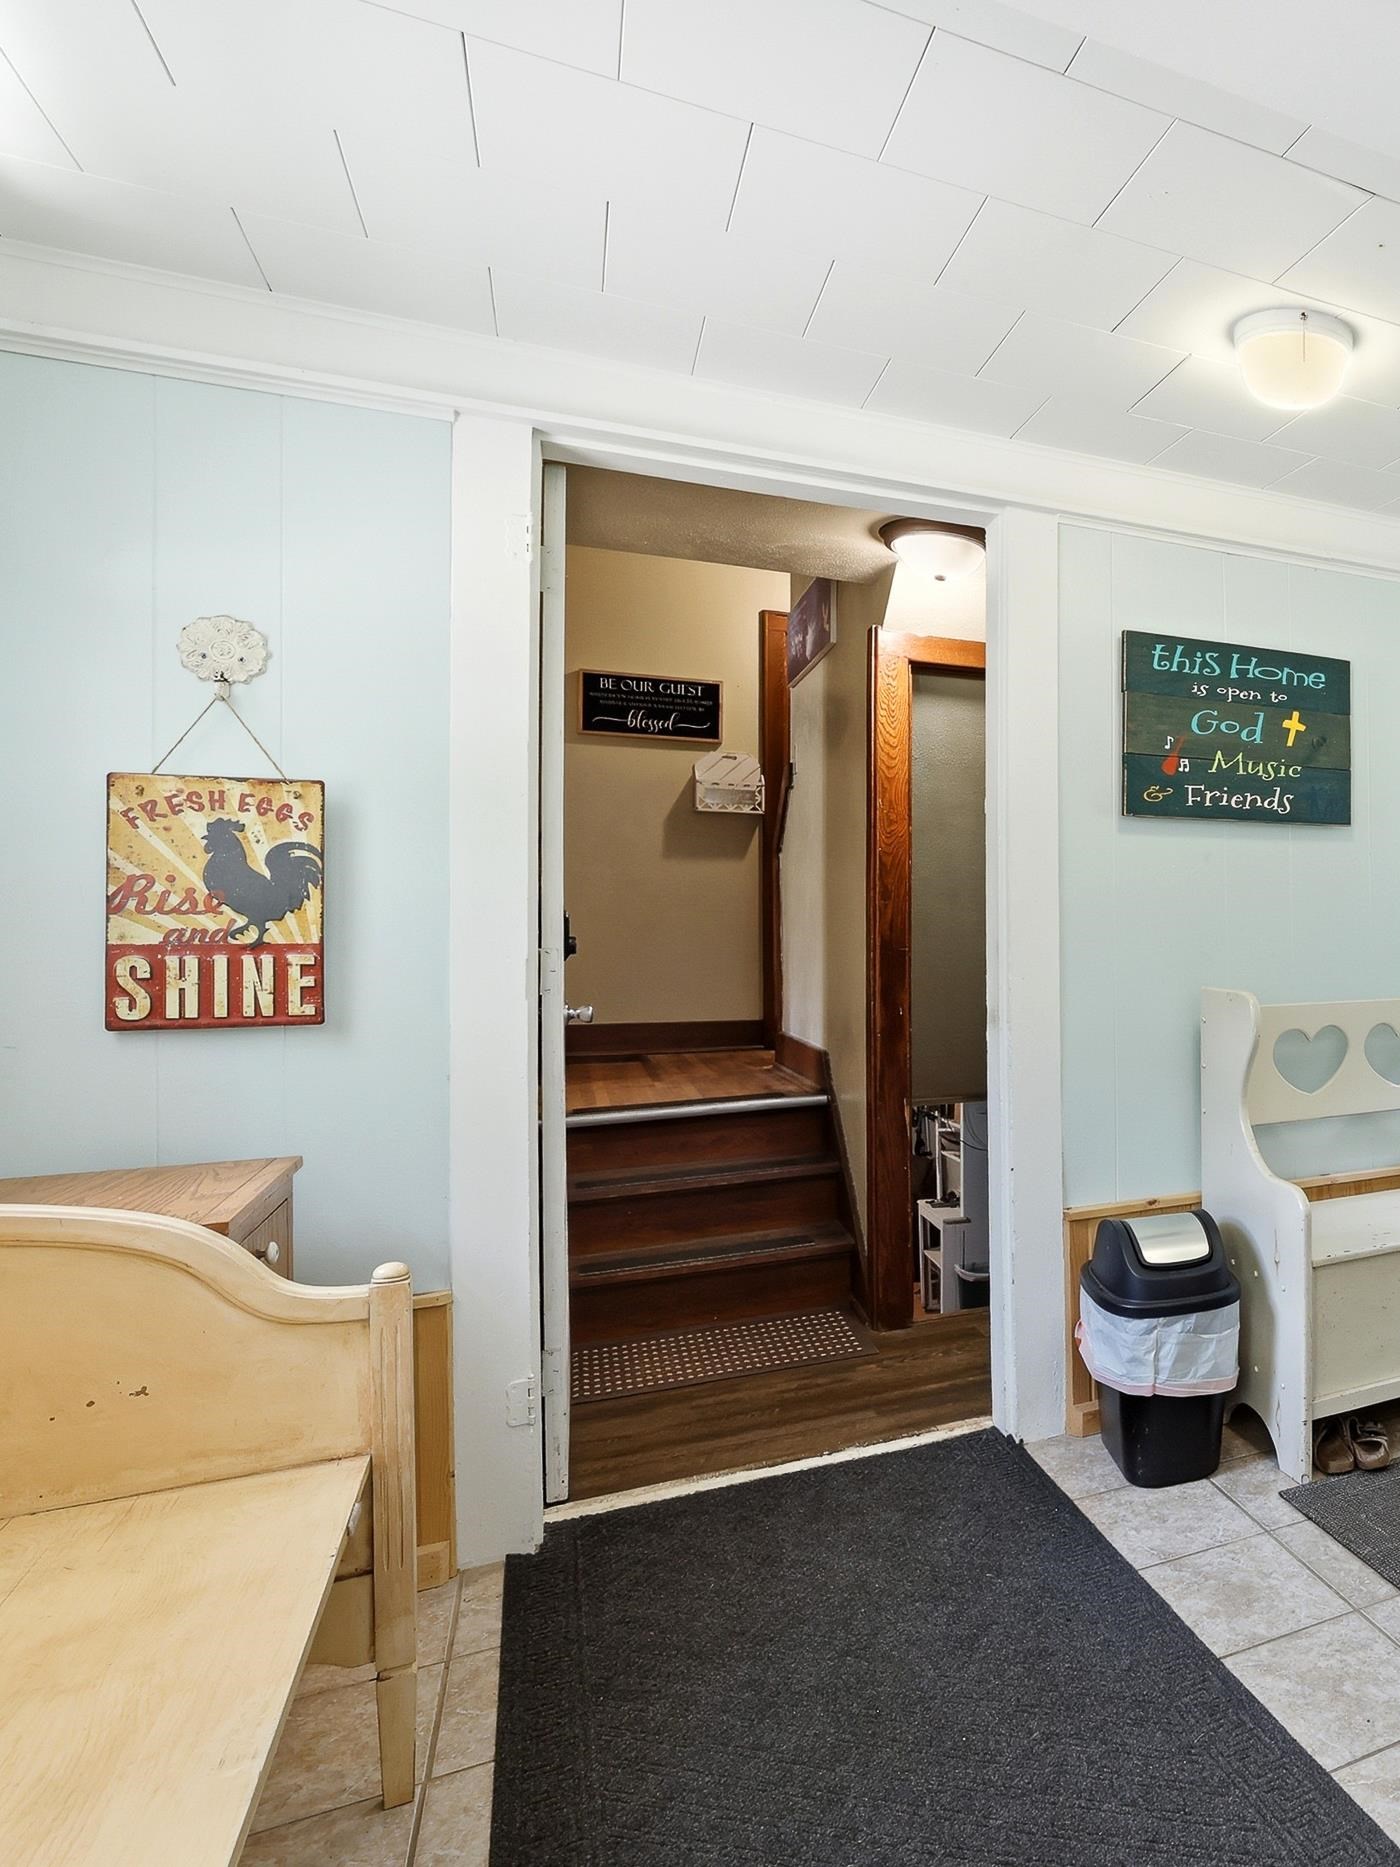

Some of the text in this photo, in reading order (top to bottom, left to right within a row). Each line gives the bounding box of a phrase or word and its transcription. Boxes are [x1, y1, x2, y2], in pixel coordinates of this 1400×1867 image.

[599, 677, 618, 690] BE
[620, 679, 655, 693] OUR
[1229, 653, 1327, 689] Home
[1191, 682, 1288, 703] is open to
[627, 708, 680, 733] blessed
[1190, 709, 1265, 744] God
[1207, 750, 1302, 781] Music
[120, 790, 316, 832] FRESH EGGS
[1143, 784, 1295, 814] & Friends
[107, 873, 227, 916] Rise
[158, 917, 239, 945] and
[112, 953, 317, 1022] SHINE
